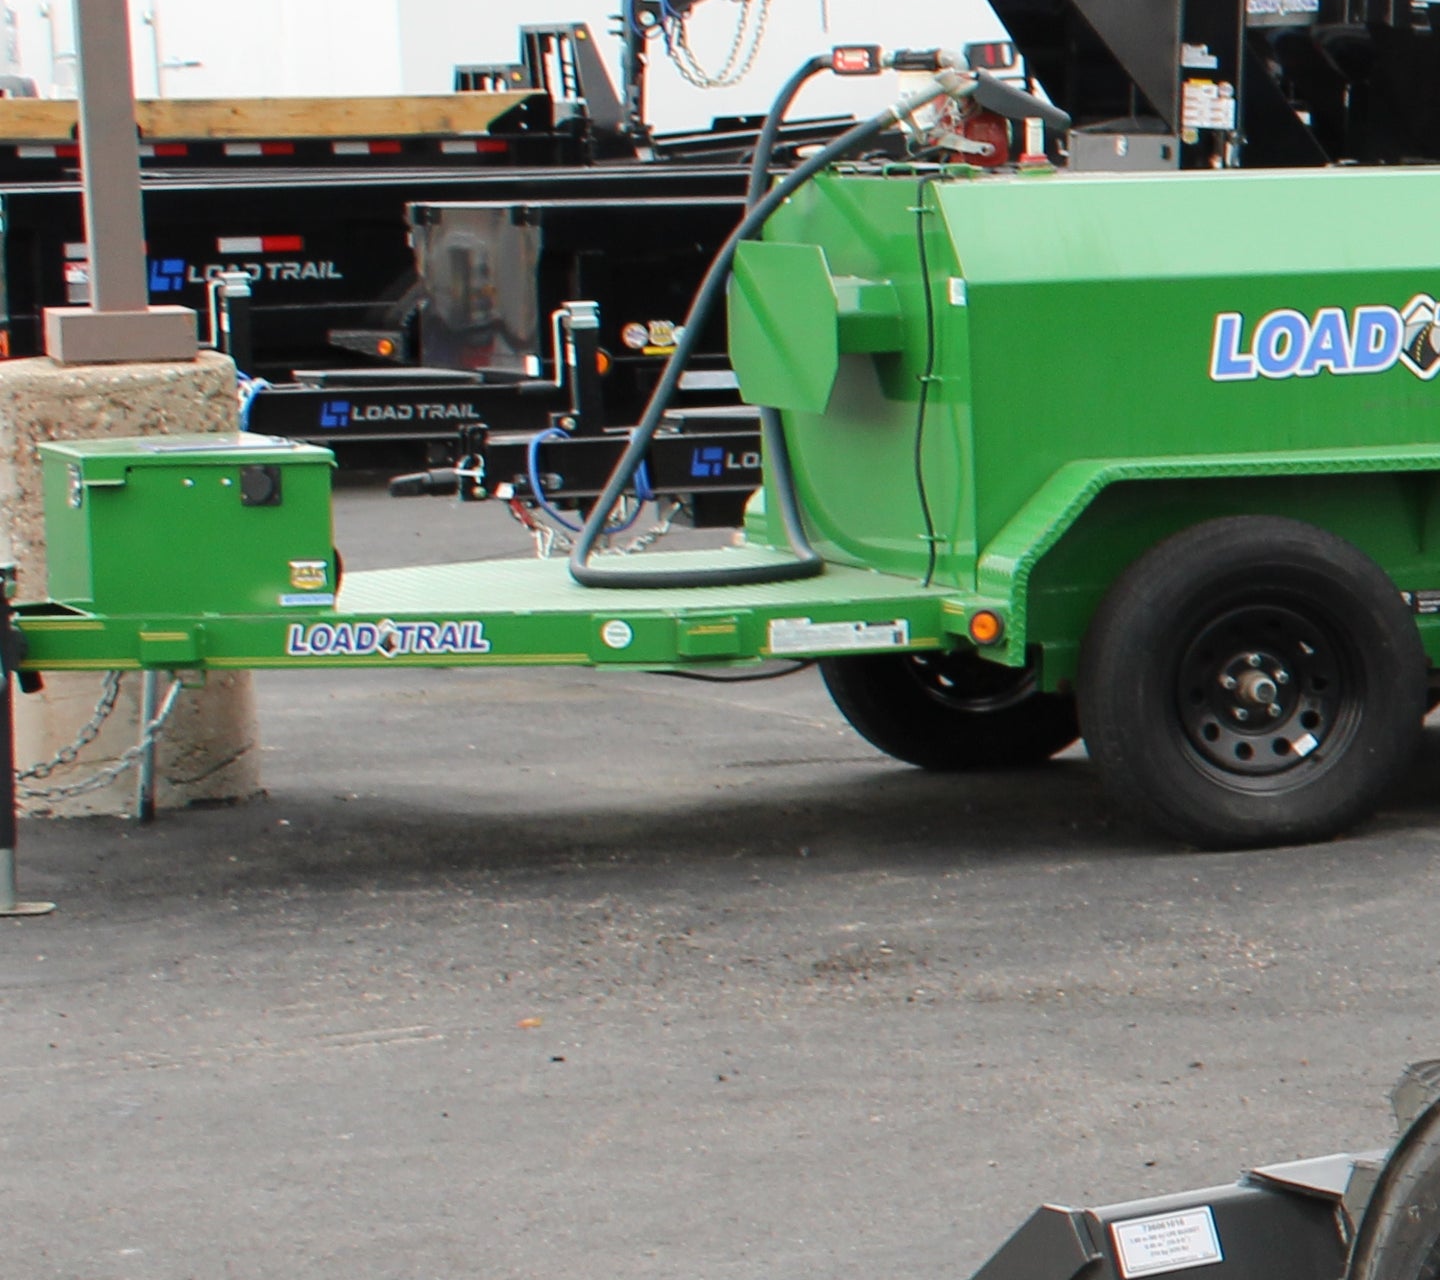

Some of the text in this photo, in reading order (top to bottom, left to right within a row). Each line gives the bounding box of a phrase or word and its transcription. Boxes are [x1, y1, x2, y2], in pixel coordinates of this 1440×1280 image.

[265, 260, 343, 280] TRAIL
[1210, 305, 1403, 381] LOAD
[352, 402, 480, 421] LOAD TRAIL
[287, 620, 491, 656] LOAD TRAIL
